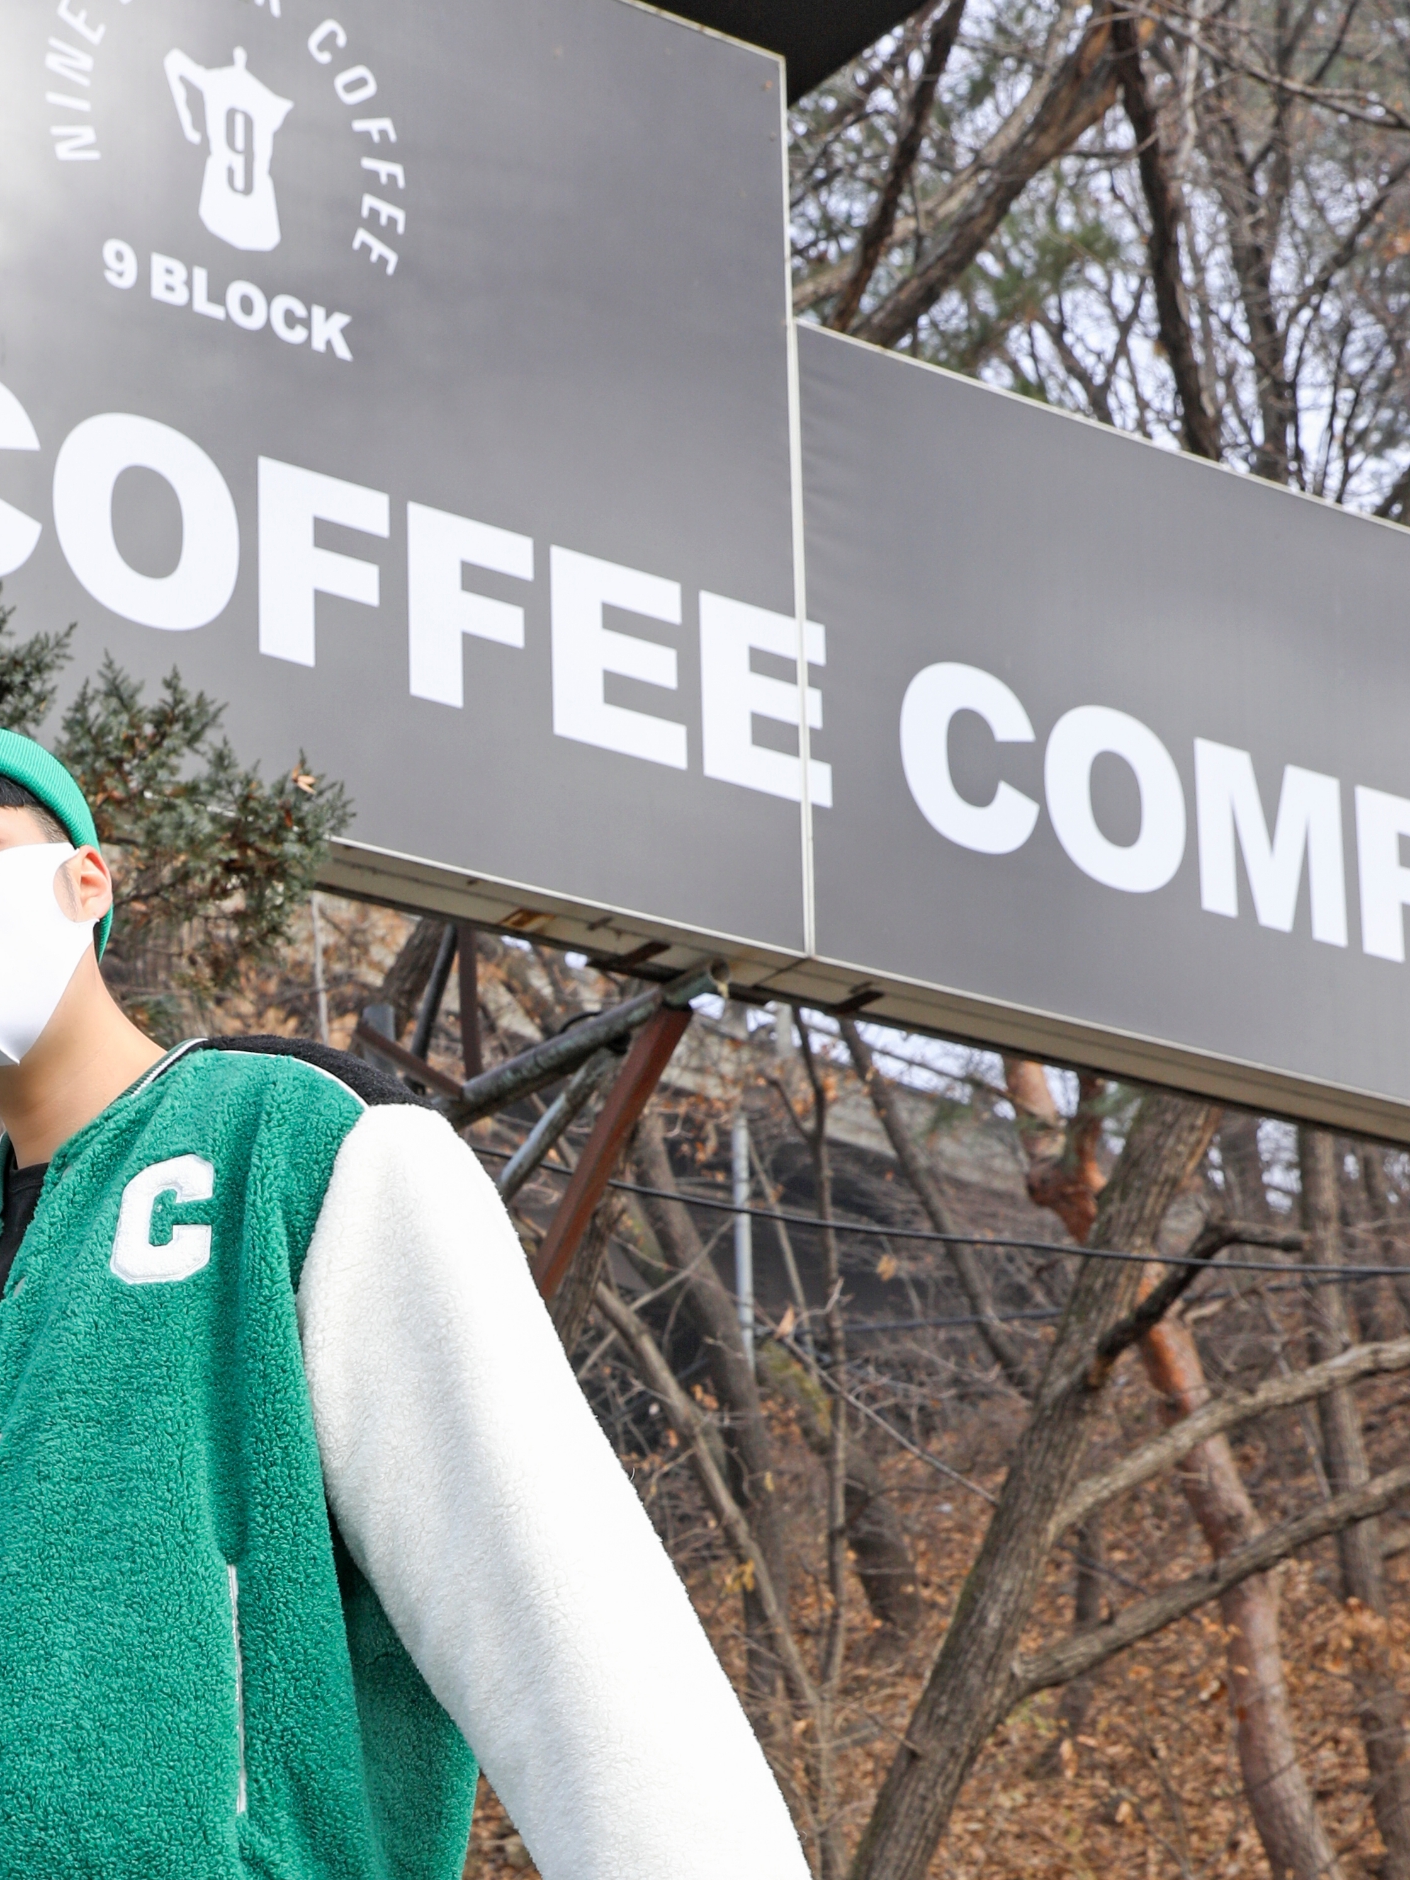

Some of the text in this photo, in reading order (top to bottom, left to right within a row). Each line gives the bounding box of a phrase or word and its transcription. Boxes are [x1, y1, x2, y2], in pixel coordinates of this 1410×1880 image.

[307, 19, 405, 275] COFFEE
[102, 238, 353, 362] 9 BLOCK
[110, 1153, 214, 1285] C
